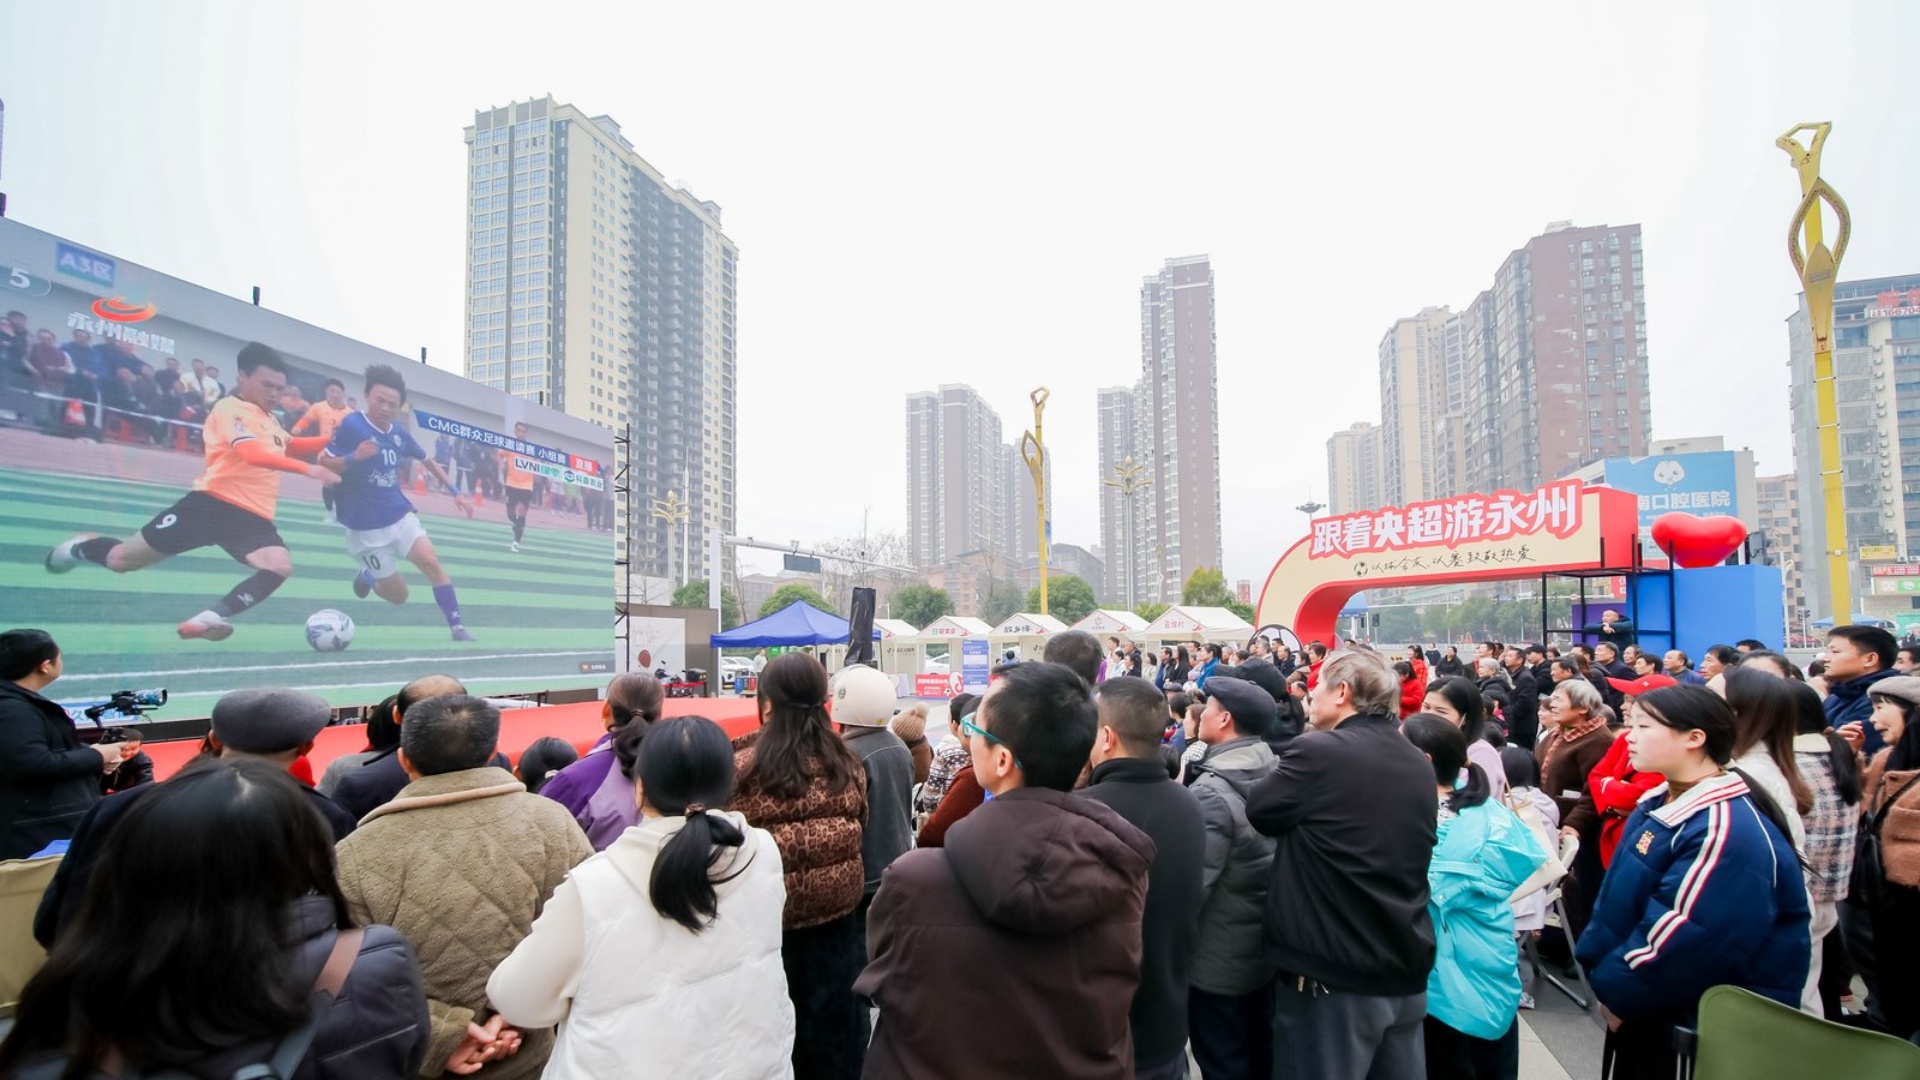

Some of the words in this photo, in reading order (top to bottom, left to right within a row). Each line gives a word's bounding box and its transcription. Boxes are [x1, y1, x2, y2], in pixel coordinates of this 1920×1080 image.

[59, 251, 113, 280] A3区
[9, 267, 31, 288] 5
[428, 417, 535, 457] CMG群众足球邀请赛
[538, 448, 567, 466] 小组赛
[381, 448, 397, 466] 10
[155, 513, 177, 529] 9
[1312, 485, 1577, 556] 跟着央超游永州
[362, 554, 381, 571] 10
